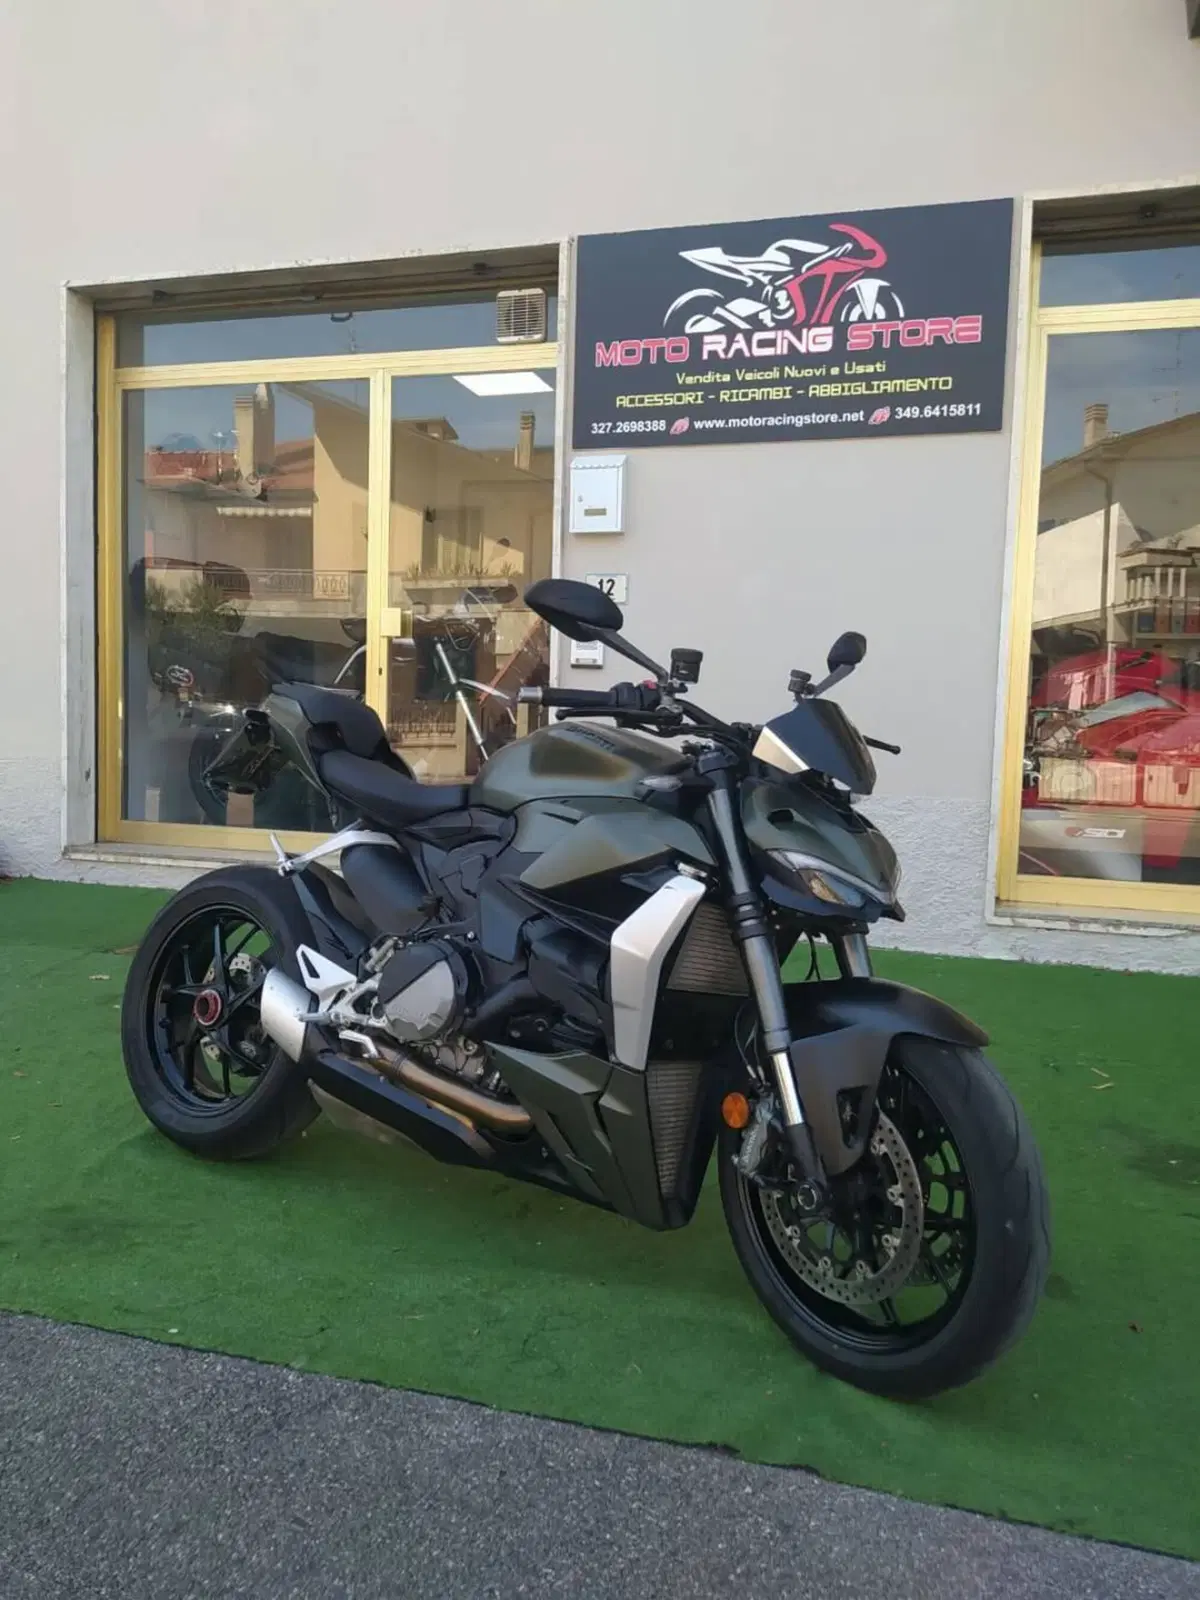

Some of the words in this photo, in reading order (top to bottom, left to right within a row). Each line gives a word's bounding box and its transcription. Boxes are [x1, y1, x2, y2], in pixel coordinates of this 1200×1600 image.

[595, 336, 690, 368] MOTO
[702, 326, 834, 360] RACING
[846, 314, 982, 351] STORE
[676, 371, 731, 385] Vendita
[735, 366, 780, 381] Veicoli
[784, 364, 826, 378] Nuovi
[830, 366, 840, 376] e
[844, 360, 886, 375] Usati
[616, 391, 704, 408] ACCESSORI
[719, 386, 793, 403] RICAMBI
[808, 376, 953, 398] ABBIGLIAMENTO
[591, 419, 667, 435] 327.2698388
[693, 409, 864, 429] www.motoracingstore.net
[895, 402, 982, 420] 349.6415811
[598, 578, 615, 596] 12
